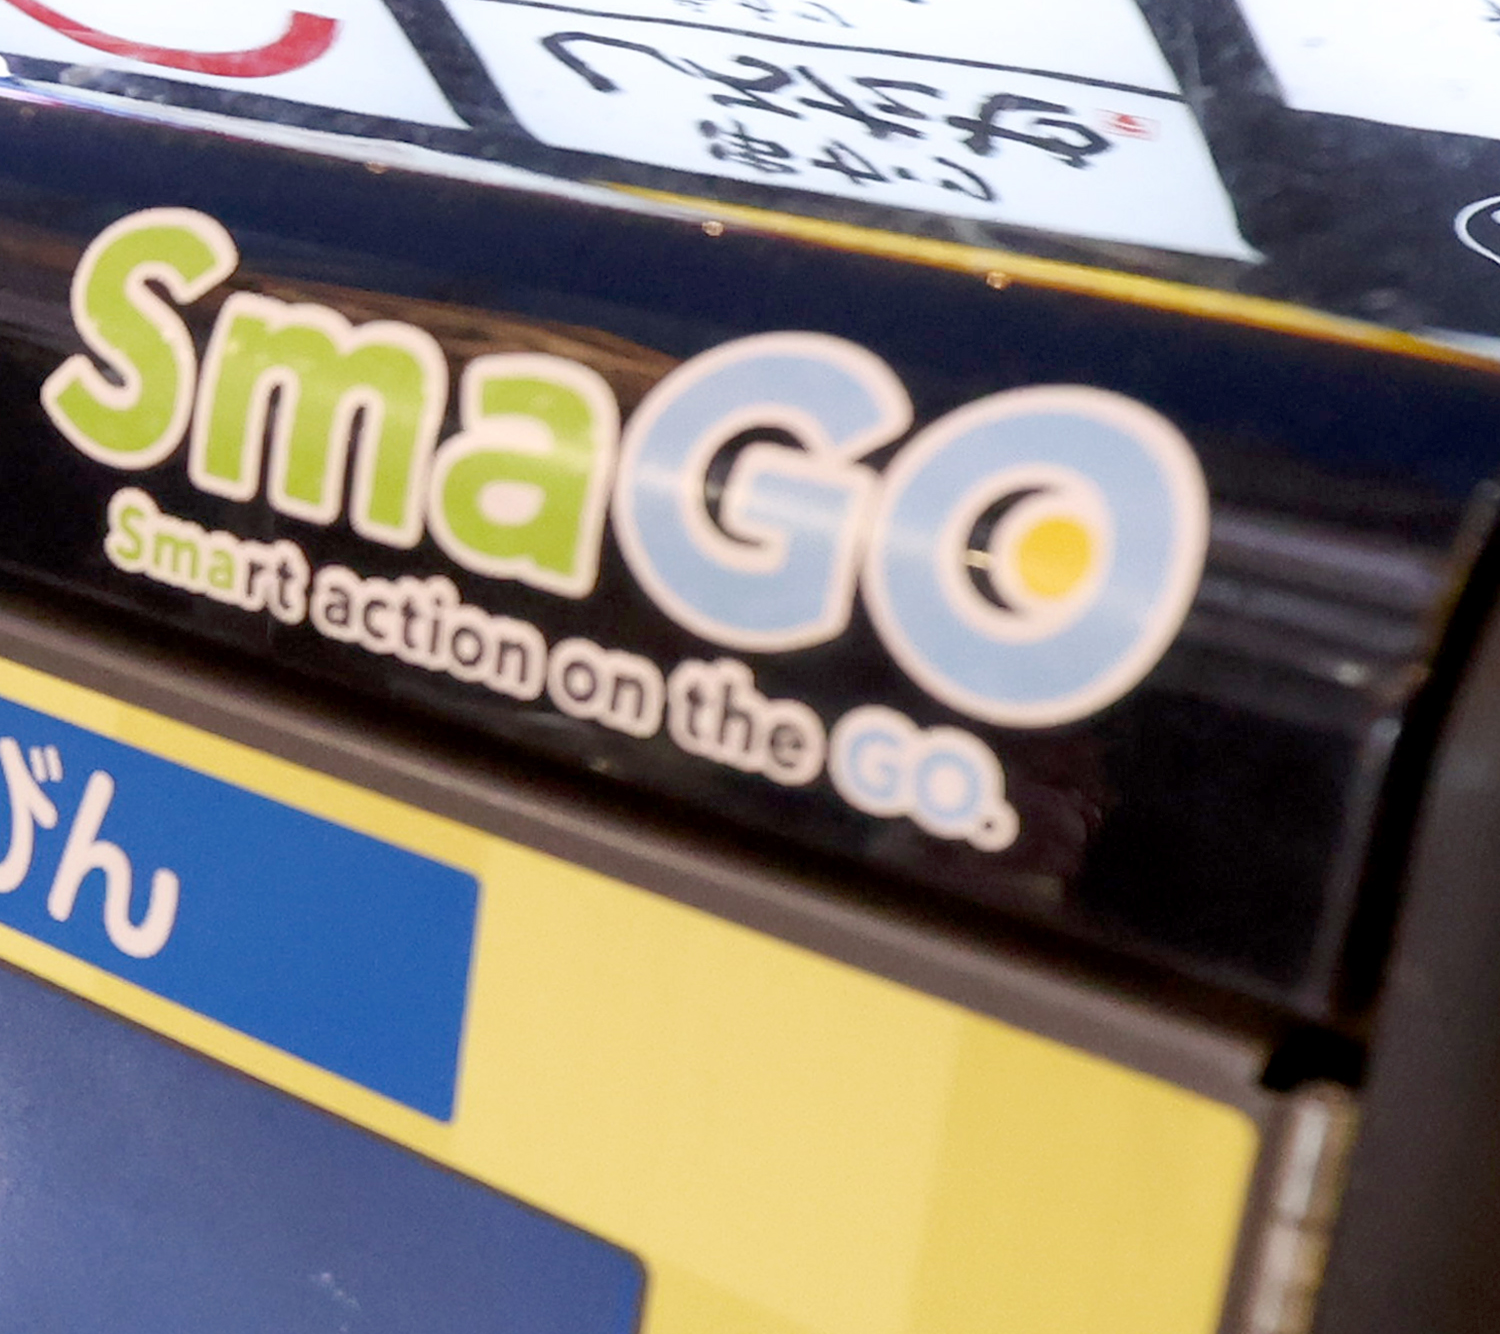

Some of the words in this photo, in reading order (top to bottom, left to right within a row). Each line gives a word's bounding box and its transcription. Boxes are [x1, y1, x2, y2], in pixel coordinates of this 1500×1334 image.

[41, 206, 1210, 729] SmaGO
[105, 490, 310, 627] Smart
[314, 560, 547, 703] action
[548, 638, 668, 738] on
[668, 662, 824, 787] the
